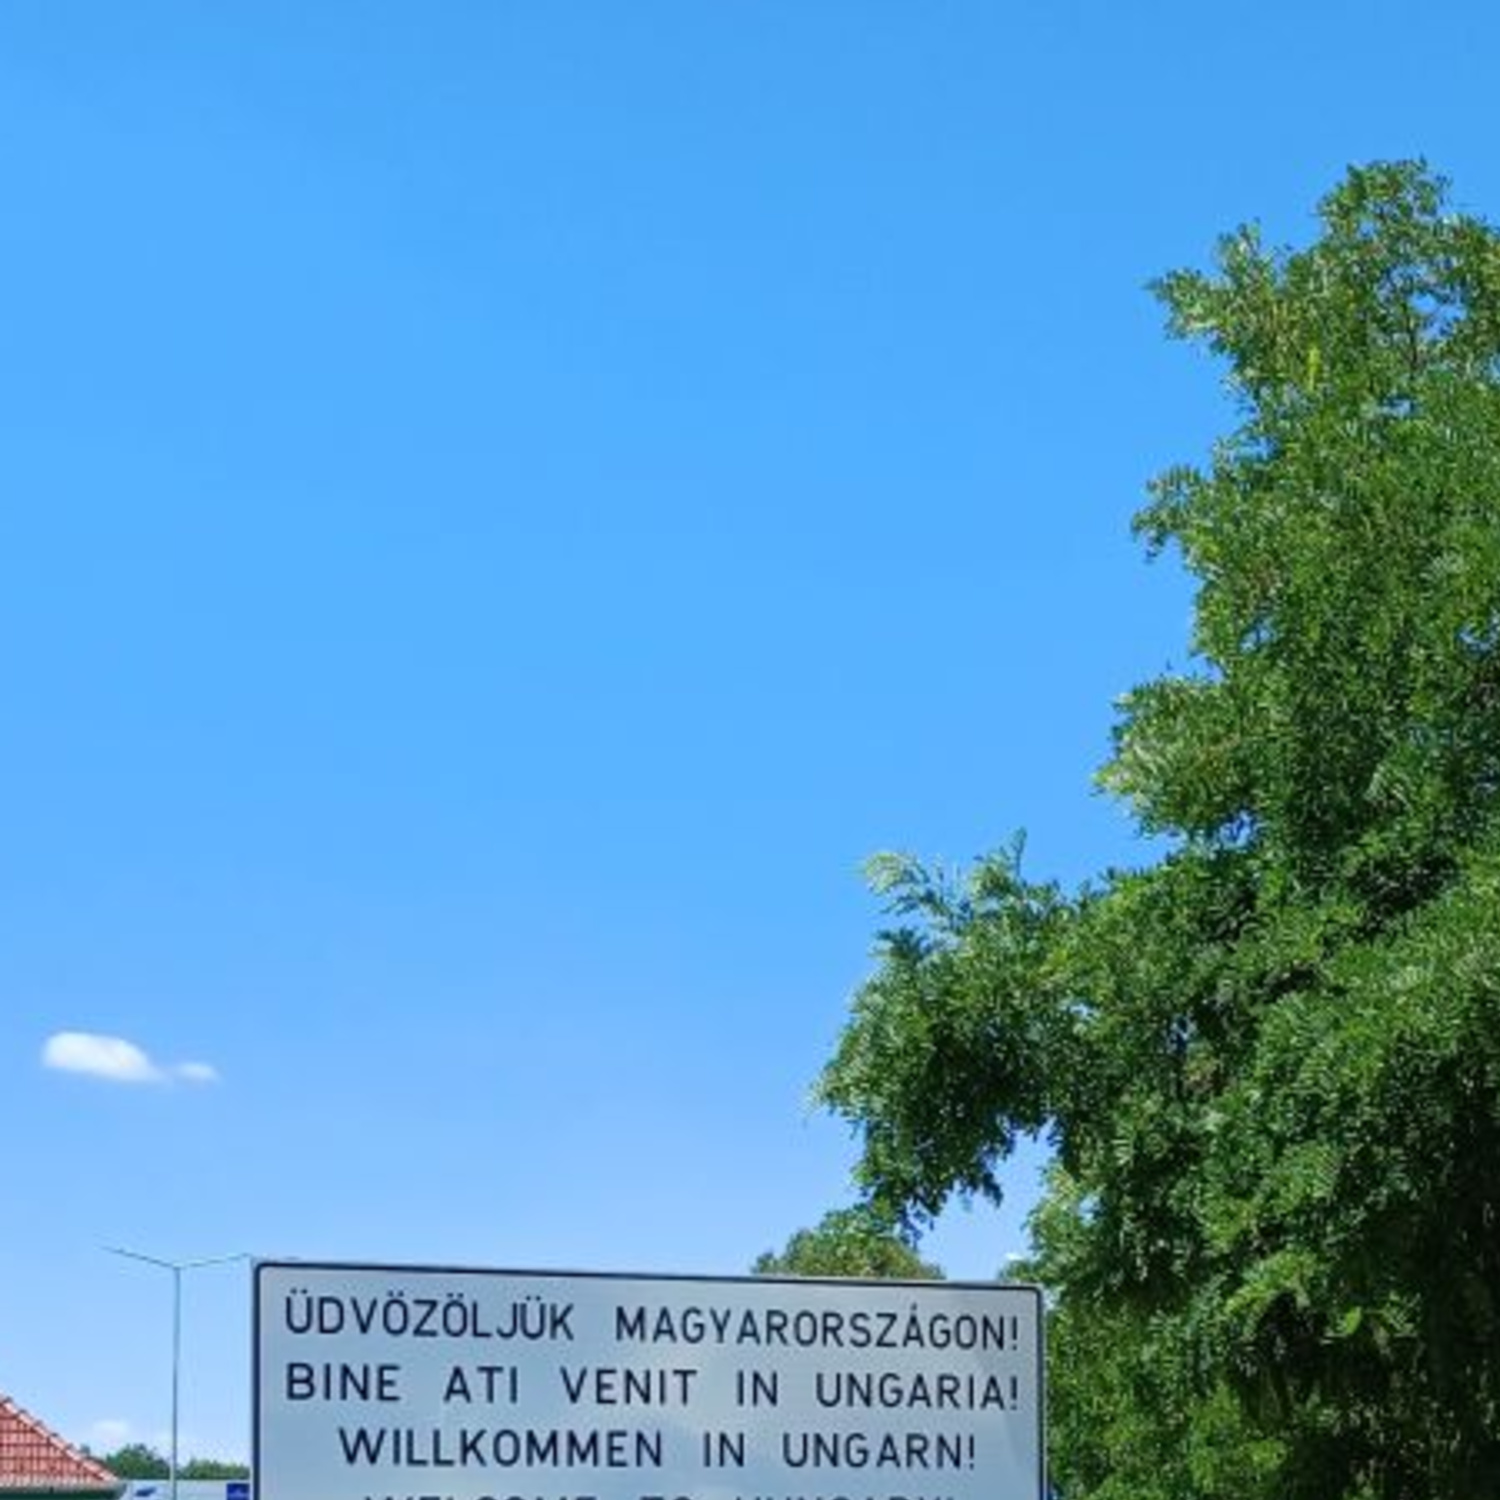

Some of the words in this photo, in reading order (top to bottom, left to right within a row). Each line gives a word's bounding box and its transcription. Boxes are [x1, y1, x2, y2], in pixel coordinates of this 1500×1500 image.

[285, 1288, 574, 1341] ÜDVÖZÖLJÜK
[615, 1303, 1018, 1352] MAGYARORSZÁGON!
[286, 1362, 401, 1402] BINE
[443, 1365, 518, 1404] ATI
[559, 1366, 698, 1406] VENIT
[737, 1370, 778, 1407] IN
[816, 1372, 1018, 1411] UNGARIA!
[338, 1427, 662, 1468] WILLKOMMEN
[703, 1432, 745, 1468] IN
[782, 1432, 975, 1470] UNGARN!
